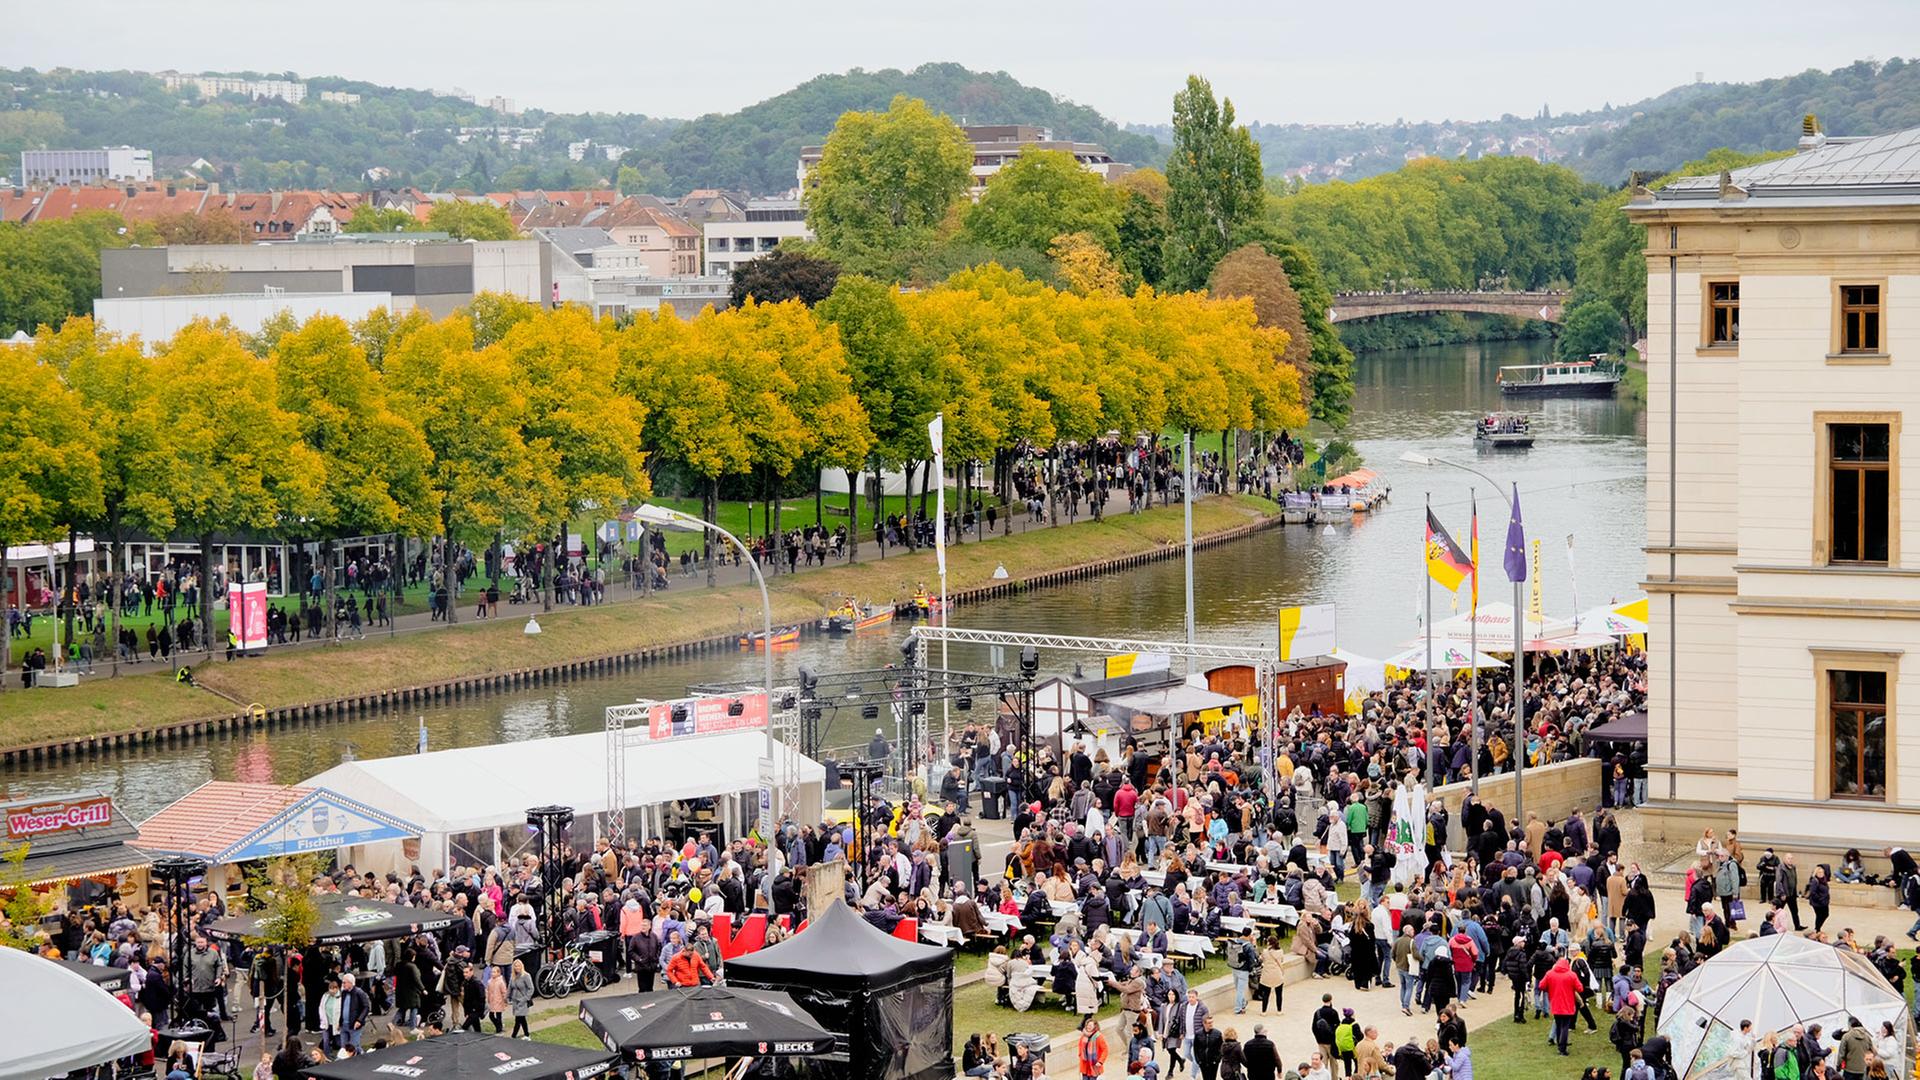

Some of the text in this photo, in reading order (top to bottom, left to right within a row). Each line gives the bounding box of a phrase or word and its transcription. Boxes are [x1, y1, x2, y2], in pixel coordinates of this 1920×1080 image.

[9, 802, 109, 834] Weser-Grill
[297, 836, 345, 851] Fischhus
[650, 1045, 694, 1060] BECK'S
[773, 1041, 815, 1053] BECK'S
